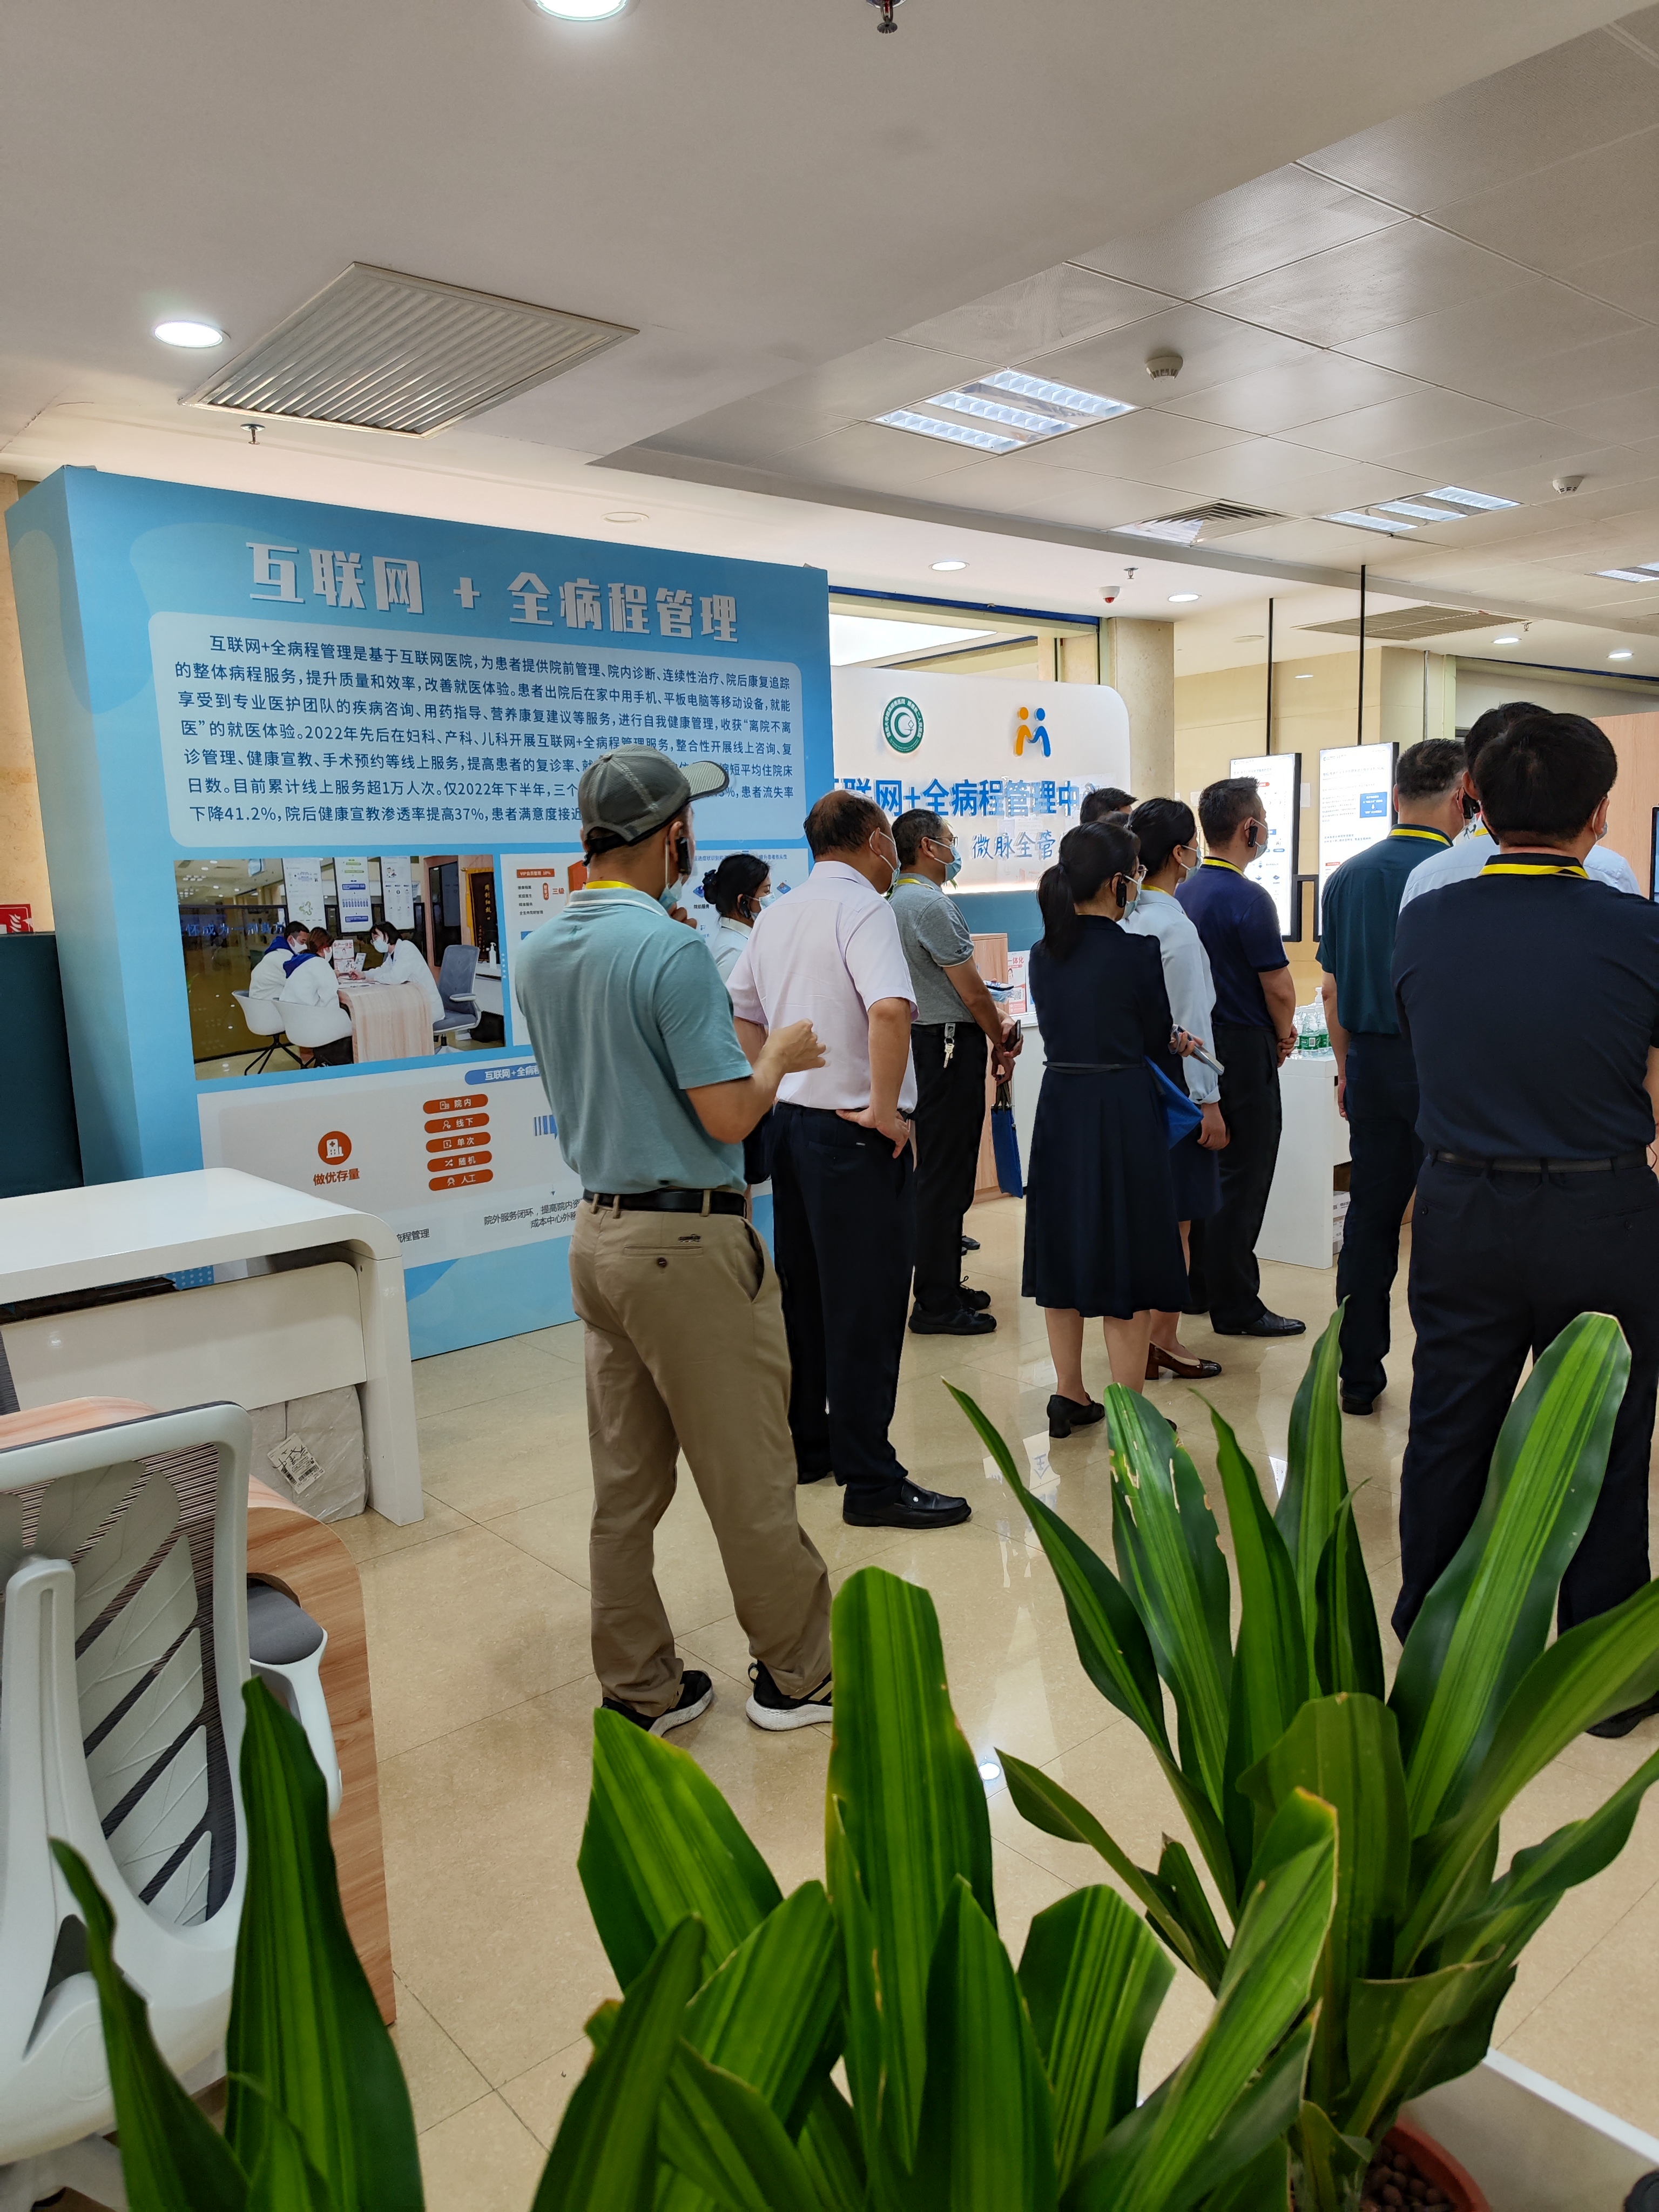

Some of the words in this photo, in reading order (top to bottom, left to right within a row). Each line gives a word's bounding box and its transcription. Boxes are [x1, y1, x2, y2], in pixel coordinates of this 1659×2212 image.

[246, 542, 423, 614] 互联网
[454, 577, 480, 609] +
[507, 572, 738, 642] 全病程管理
[716, 785, 794, 799] %，患者流失率
[835, 778, 1096, 817] 网+全病程管理中
[972, 830, 1056, 860] 微脉全管
[454, 1098, 471, 1108] 院内
[456, 1117, 474, 1128] 线下
[457, 1136, 475, 1147] 单次
[458, 1156, 476, 1166] 随机
[313, 1168, 360, 1186] 做优存量
[461, 1174, 476, 1184] 人工
